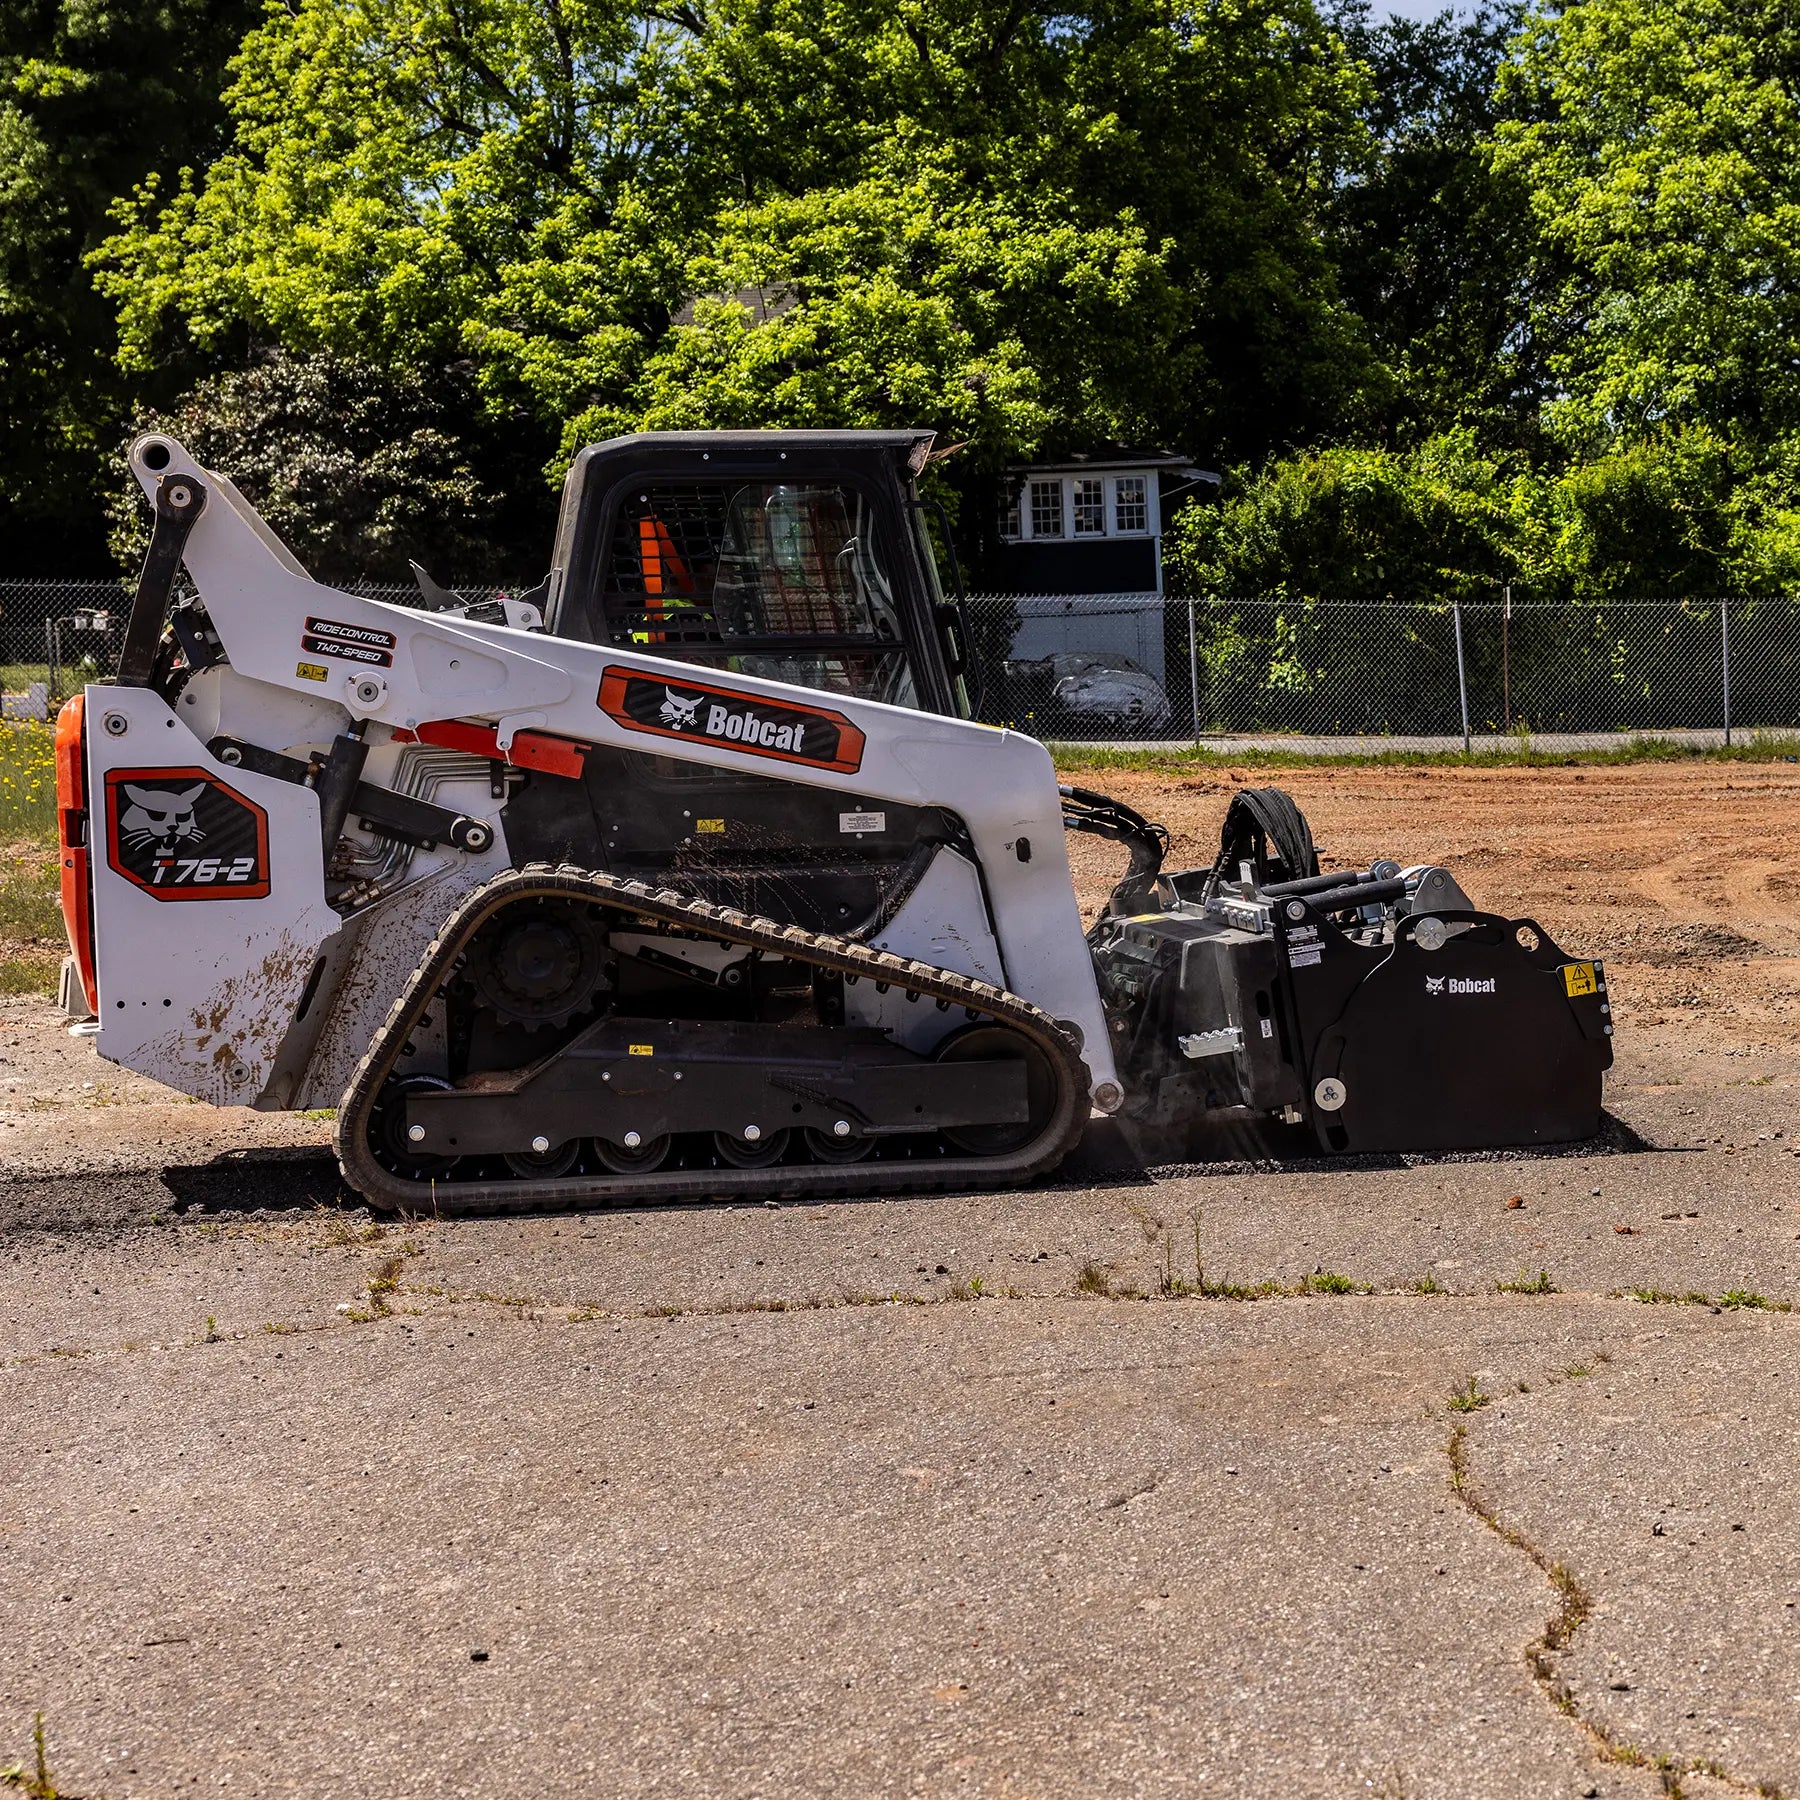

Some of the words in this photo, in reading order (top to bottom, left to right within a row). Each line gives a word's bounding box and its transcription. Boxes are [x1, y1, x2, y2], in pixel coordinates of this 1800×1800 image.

[316, 641, 382, 662] TWO-SPEED
[706, 704, 805, 752] Bobcat
[1448, 977, 1496, 993] Bobcat
